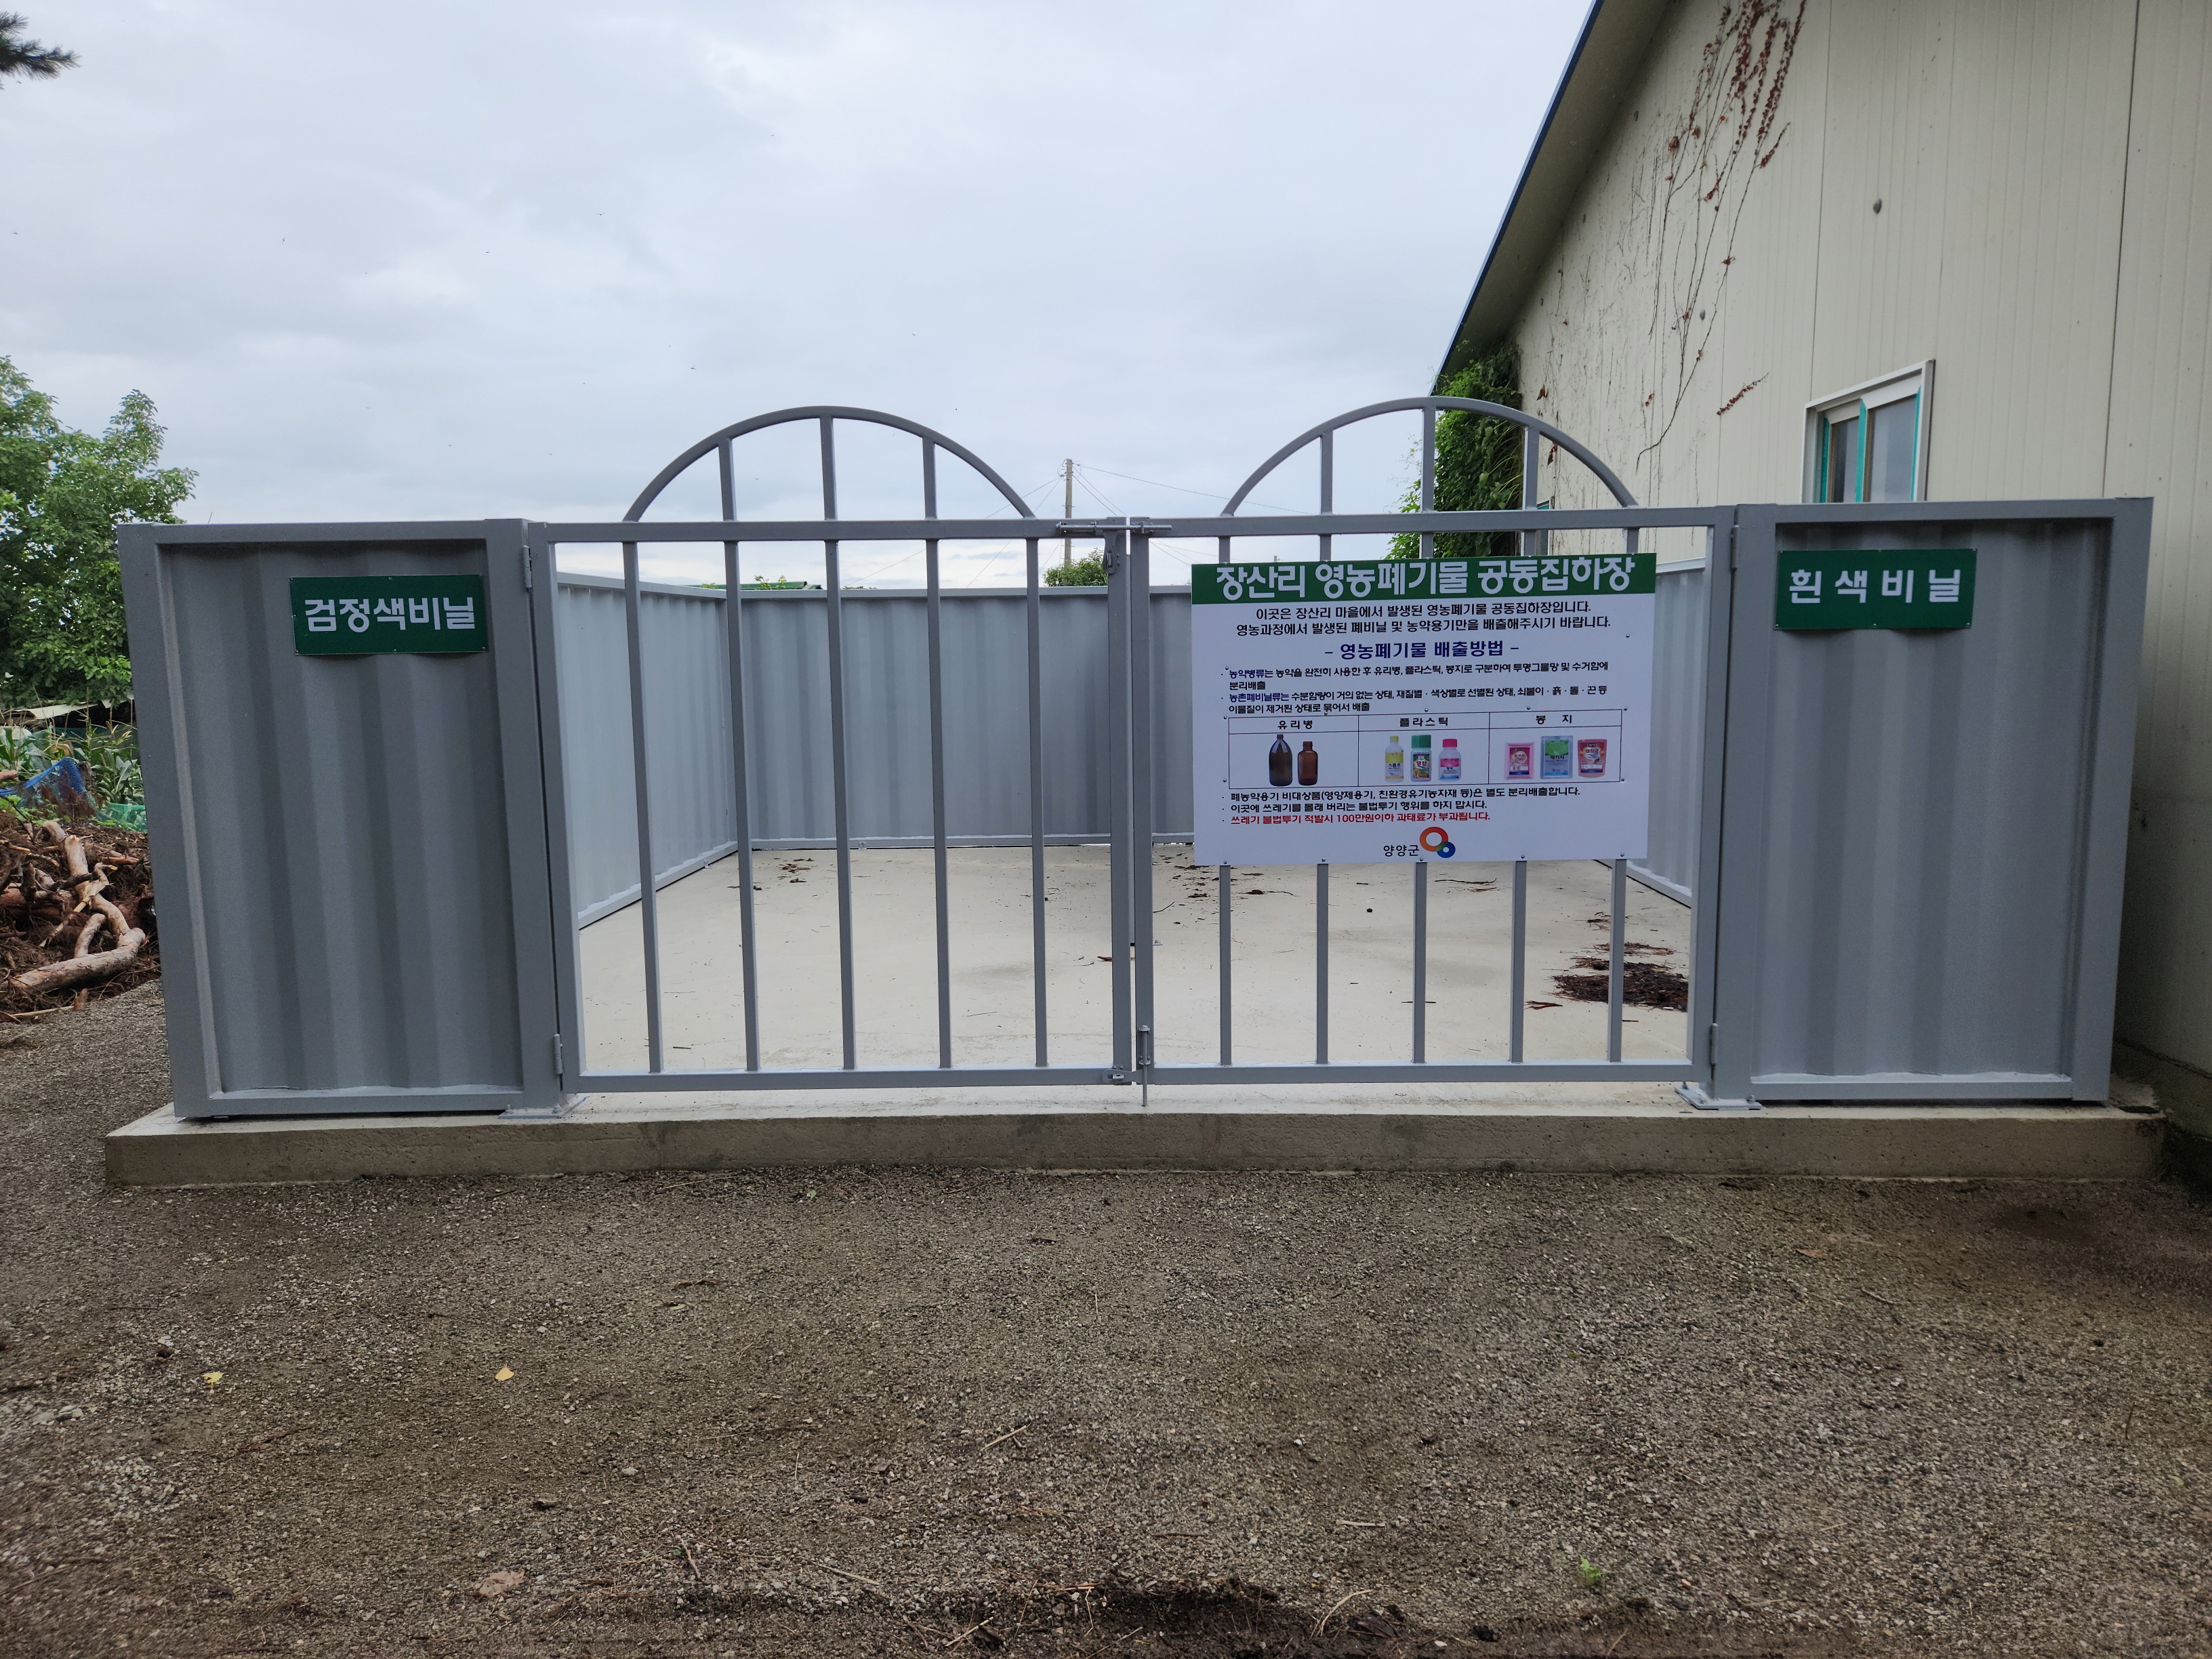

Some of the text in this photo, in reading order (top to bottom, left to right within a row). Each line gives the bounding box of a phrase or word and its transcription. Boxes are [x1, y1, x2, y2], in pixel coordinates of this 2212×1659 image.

[1217, 556, 1635, 600] 장산리 영농폐기물 공동집하장
[304, 597, 475, 633] 검정색비닐
[1256, 601, 1591, 619] 이곳은 장산리 마을에서 발생된 영농폐기물 공동집하장입니다.
[1237, 617, 1610, 636] 영농과정에서 발생된 폐비닐 및 농약용기만을 배출해주시기 바랍니다.
[1340, 640, 1503, 659] 영농폐기물 배출방법
[1229, 670, 1273, 678] 농약병류는
[1276, 668, 1302, 678] 농약을
[1305, 668, 1331, 677] 완전히
[1334, 668, 1360, 676] 사용한
[1363, 667, 1371, 675] 후
[1374, 666, 1403, 676] 유리병,
[1405, 665, 1443, 674] 플라스틱,
[1446, 664, 1472, 674] 봉지로
[1475, 663, 1511, 673] 구분하여
[1561, 663, 1570, 671] 및
[1572, 661, 1607, 671] 수거함에
[1229, 681, 1266, 691] 분리배출
[1229, 693, 1289, 702] 농촌폐비닐류는
[1292, 691, 1334, 701] 수분함량이
[1337, 691, 1353, 700] 거의
[1355, 691, 1372, 699] 없는
[1375, 690, 1394, 699] 상태,
[1396, 689, 1422, 699] 재질별
[1431, 689, 1465, 697] 색상별로
[1468, 688, 1494, 697] 선별된
[1496, 687, 1515, 697] 상태,
[1552, 687, 1561, 695] 흙
[1598, 686, 1607, 694] 등
[1229, 703, 1370, 714] 이물질이 제거된 상태로 묶어서 배출
[1231, 792, 1279, 802] 폐농약용기
[1379, 790, 1456, 799] 친환경유기농자재
[1460, 789, 1482, 798] 등)은
[1486, 788, 1505, 796] 별도
[1509, 787, 1580, 796] 분리배출합니다.
[1231, 804, 1259, 813] 이곳에
[1263, 804, 1301, 813] 쓰레기를
[1305, 803, 1323, 812] 몰래
[1359, 802, 1397, 811] 불법투기
[1401, 801, 1429, 810] 행위를
[1433, 800, 1452, 809] 하지
[1456, 800, 1487, 809] 맙시다.
[1231, 812, 1490, 825] 쓰레기 불법투기 적발시 100만원이하 과태료가 부과됩니다.
[1383, 845, 1419, 857] 양양군
